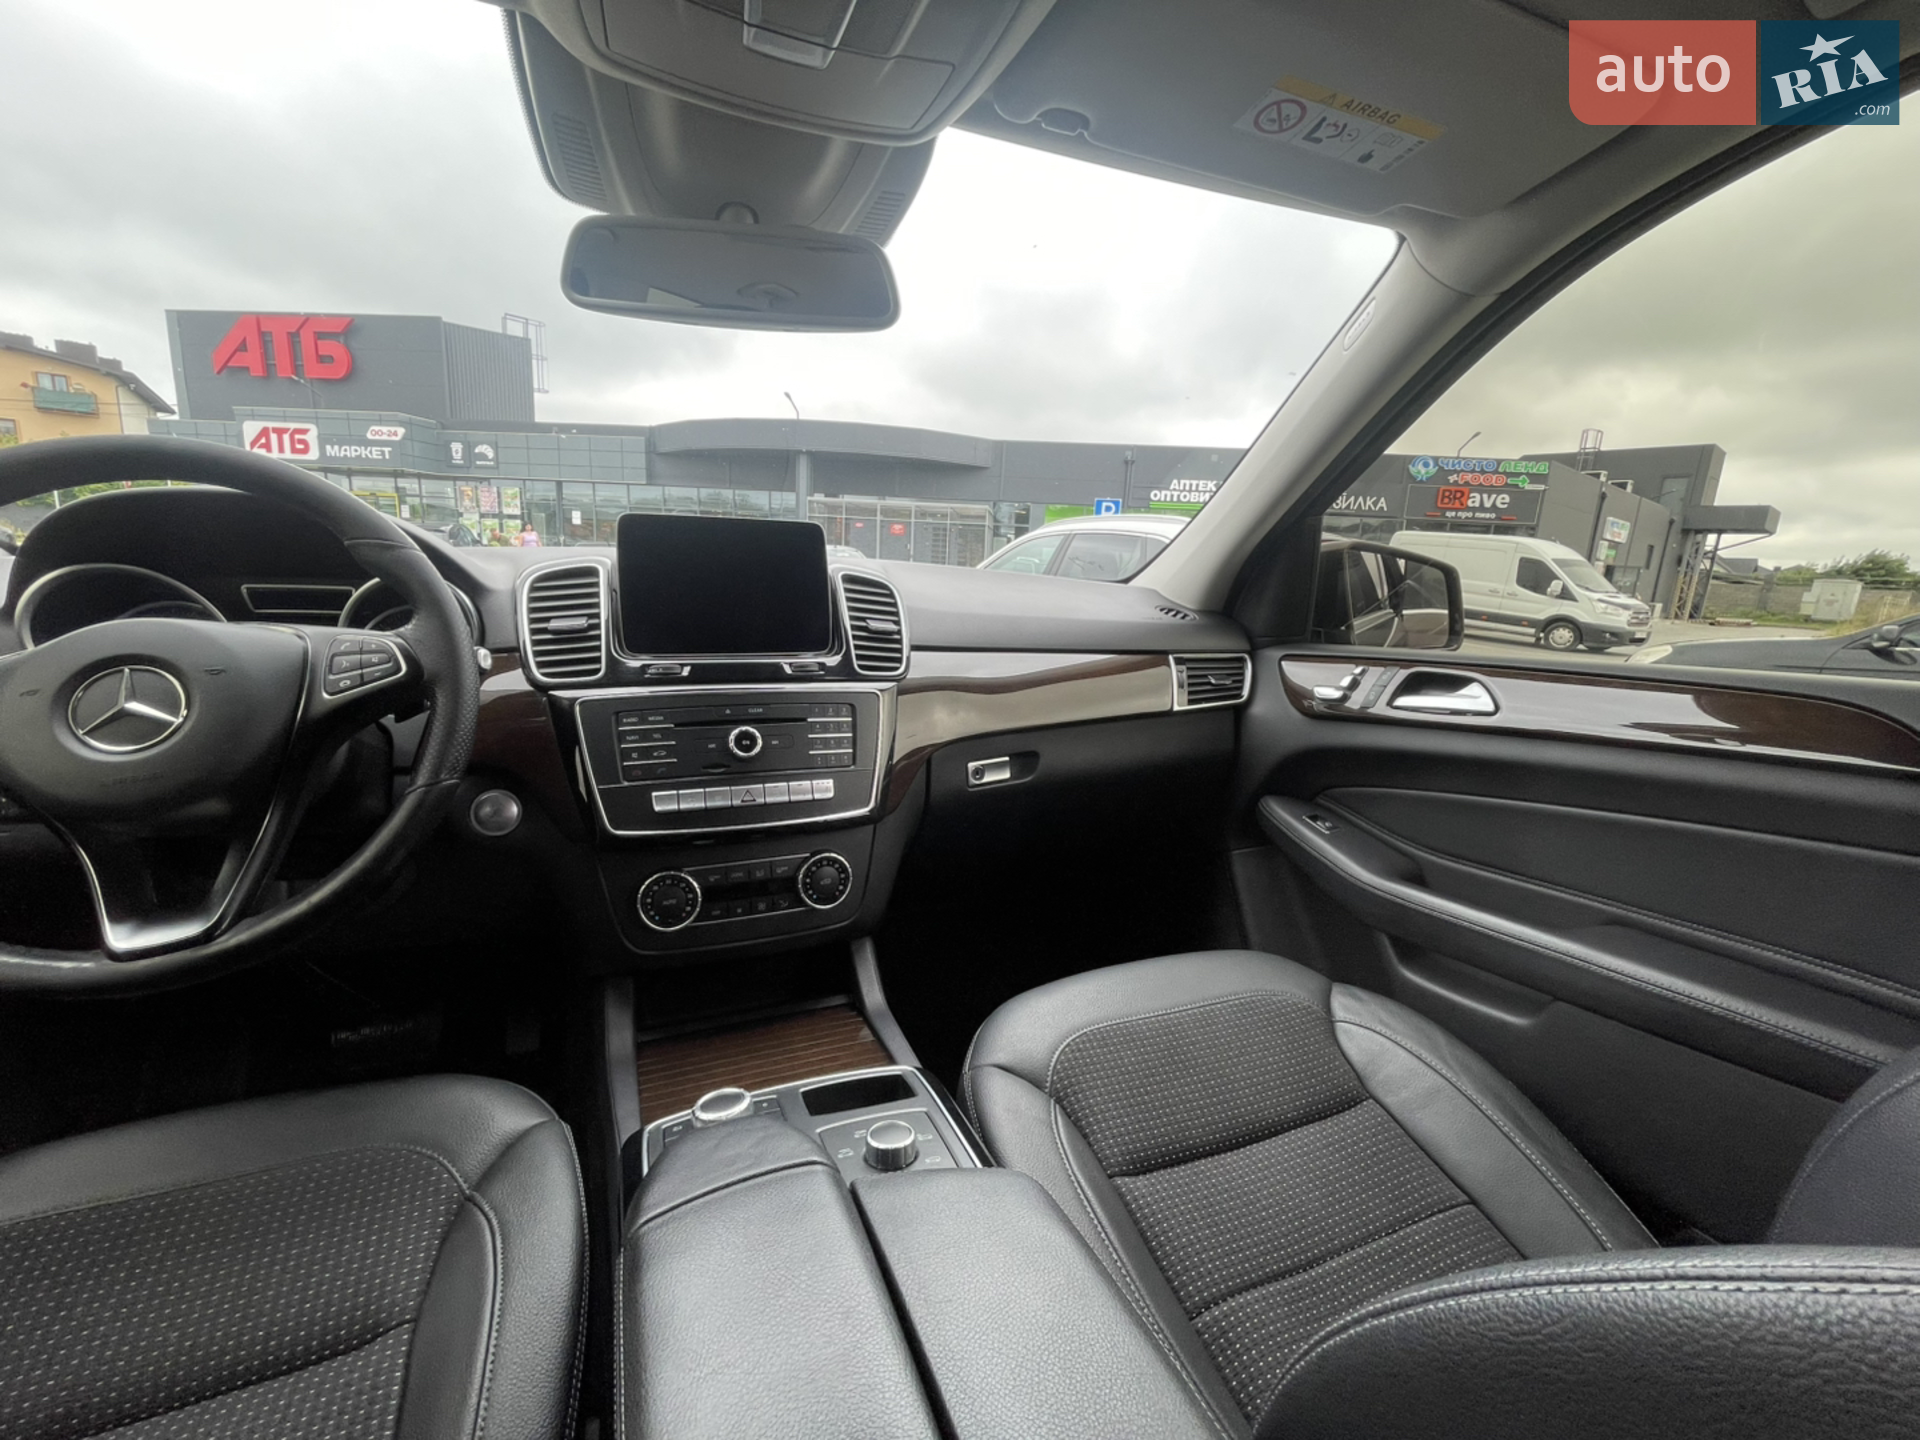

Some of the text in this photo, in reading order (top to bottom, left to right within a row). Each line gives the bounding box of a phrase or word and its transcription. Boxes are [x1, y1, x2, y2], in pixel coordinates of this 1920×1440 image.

[1341, 98, 1402, 125] AIRBAG
[211, 314, 355, 380] АТБ
[249, 426, 311, 455] АТБ
[370, 429, 399, 438] 00-24
[325, 444, 392, 459] МАРКЕТ
[1438, 458, 1549, 474] ЧИСТО ЛЕНД
[1169, 479, 1221, 492] АПТЕК
[1439, 488, 1511, 508] BRave
